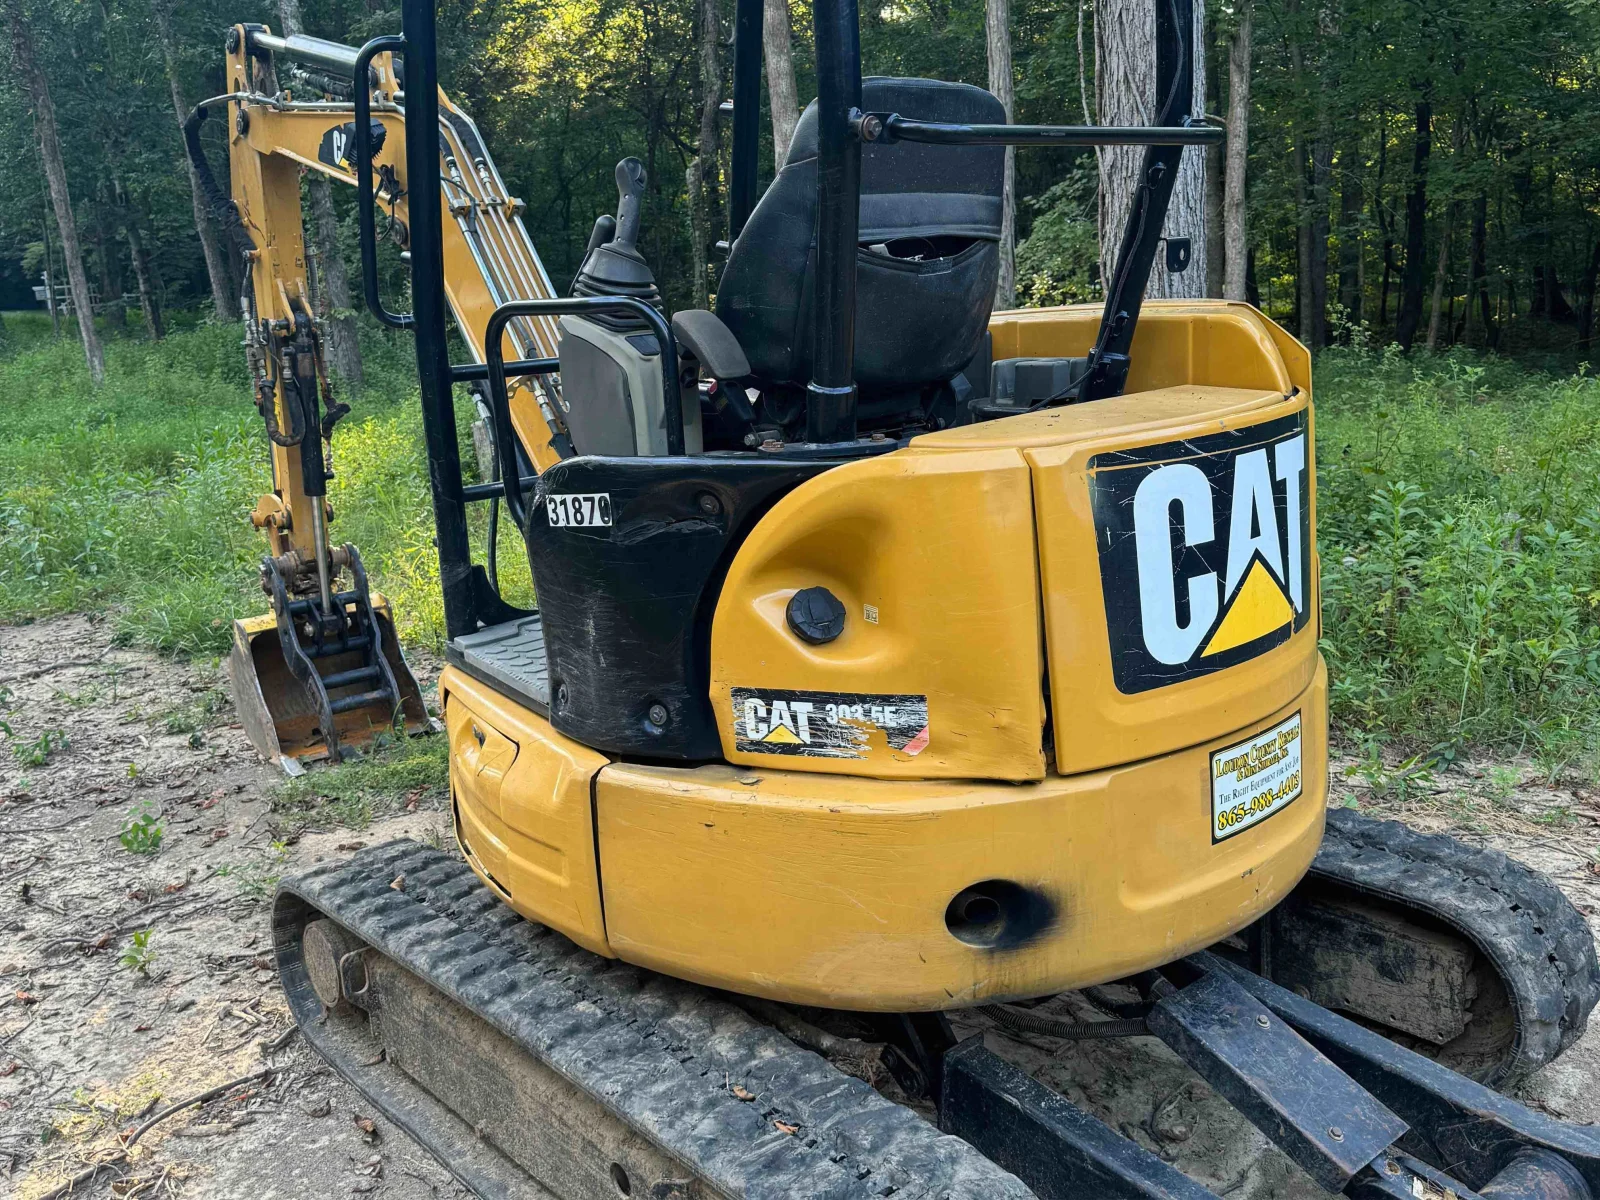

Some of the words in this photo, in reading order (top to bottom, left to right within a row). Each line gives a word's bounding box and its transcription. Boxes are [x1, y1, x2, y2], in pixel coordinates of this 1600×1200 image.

[1133, 433, 1304, 665] CAT
[744, 698, 813, 744] CAT
[1219, 793, 1231, 805] THE
[1232, 785, 1249, 800] RIGHT
[1250, 772, 1276, 792] EQUIPMENT
[1236, 767, 1244, 782] &
[1217, 769, 1300, 831] 865-988-4403
